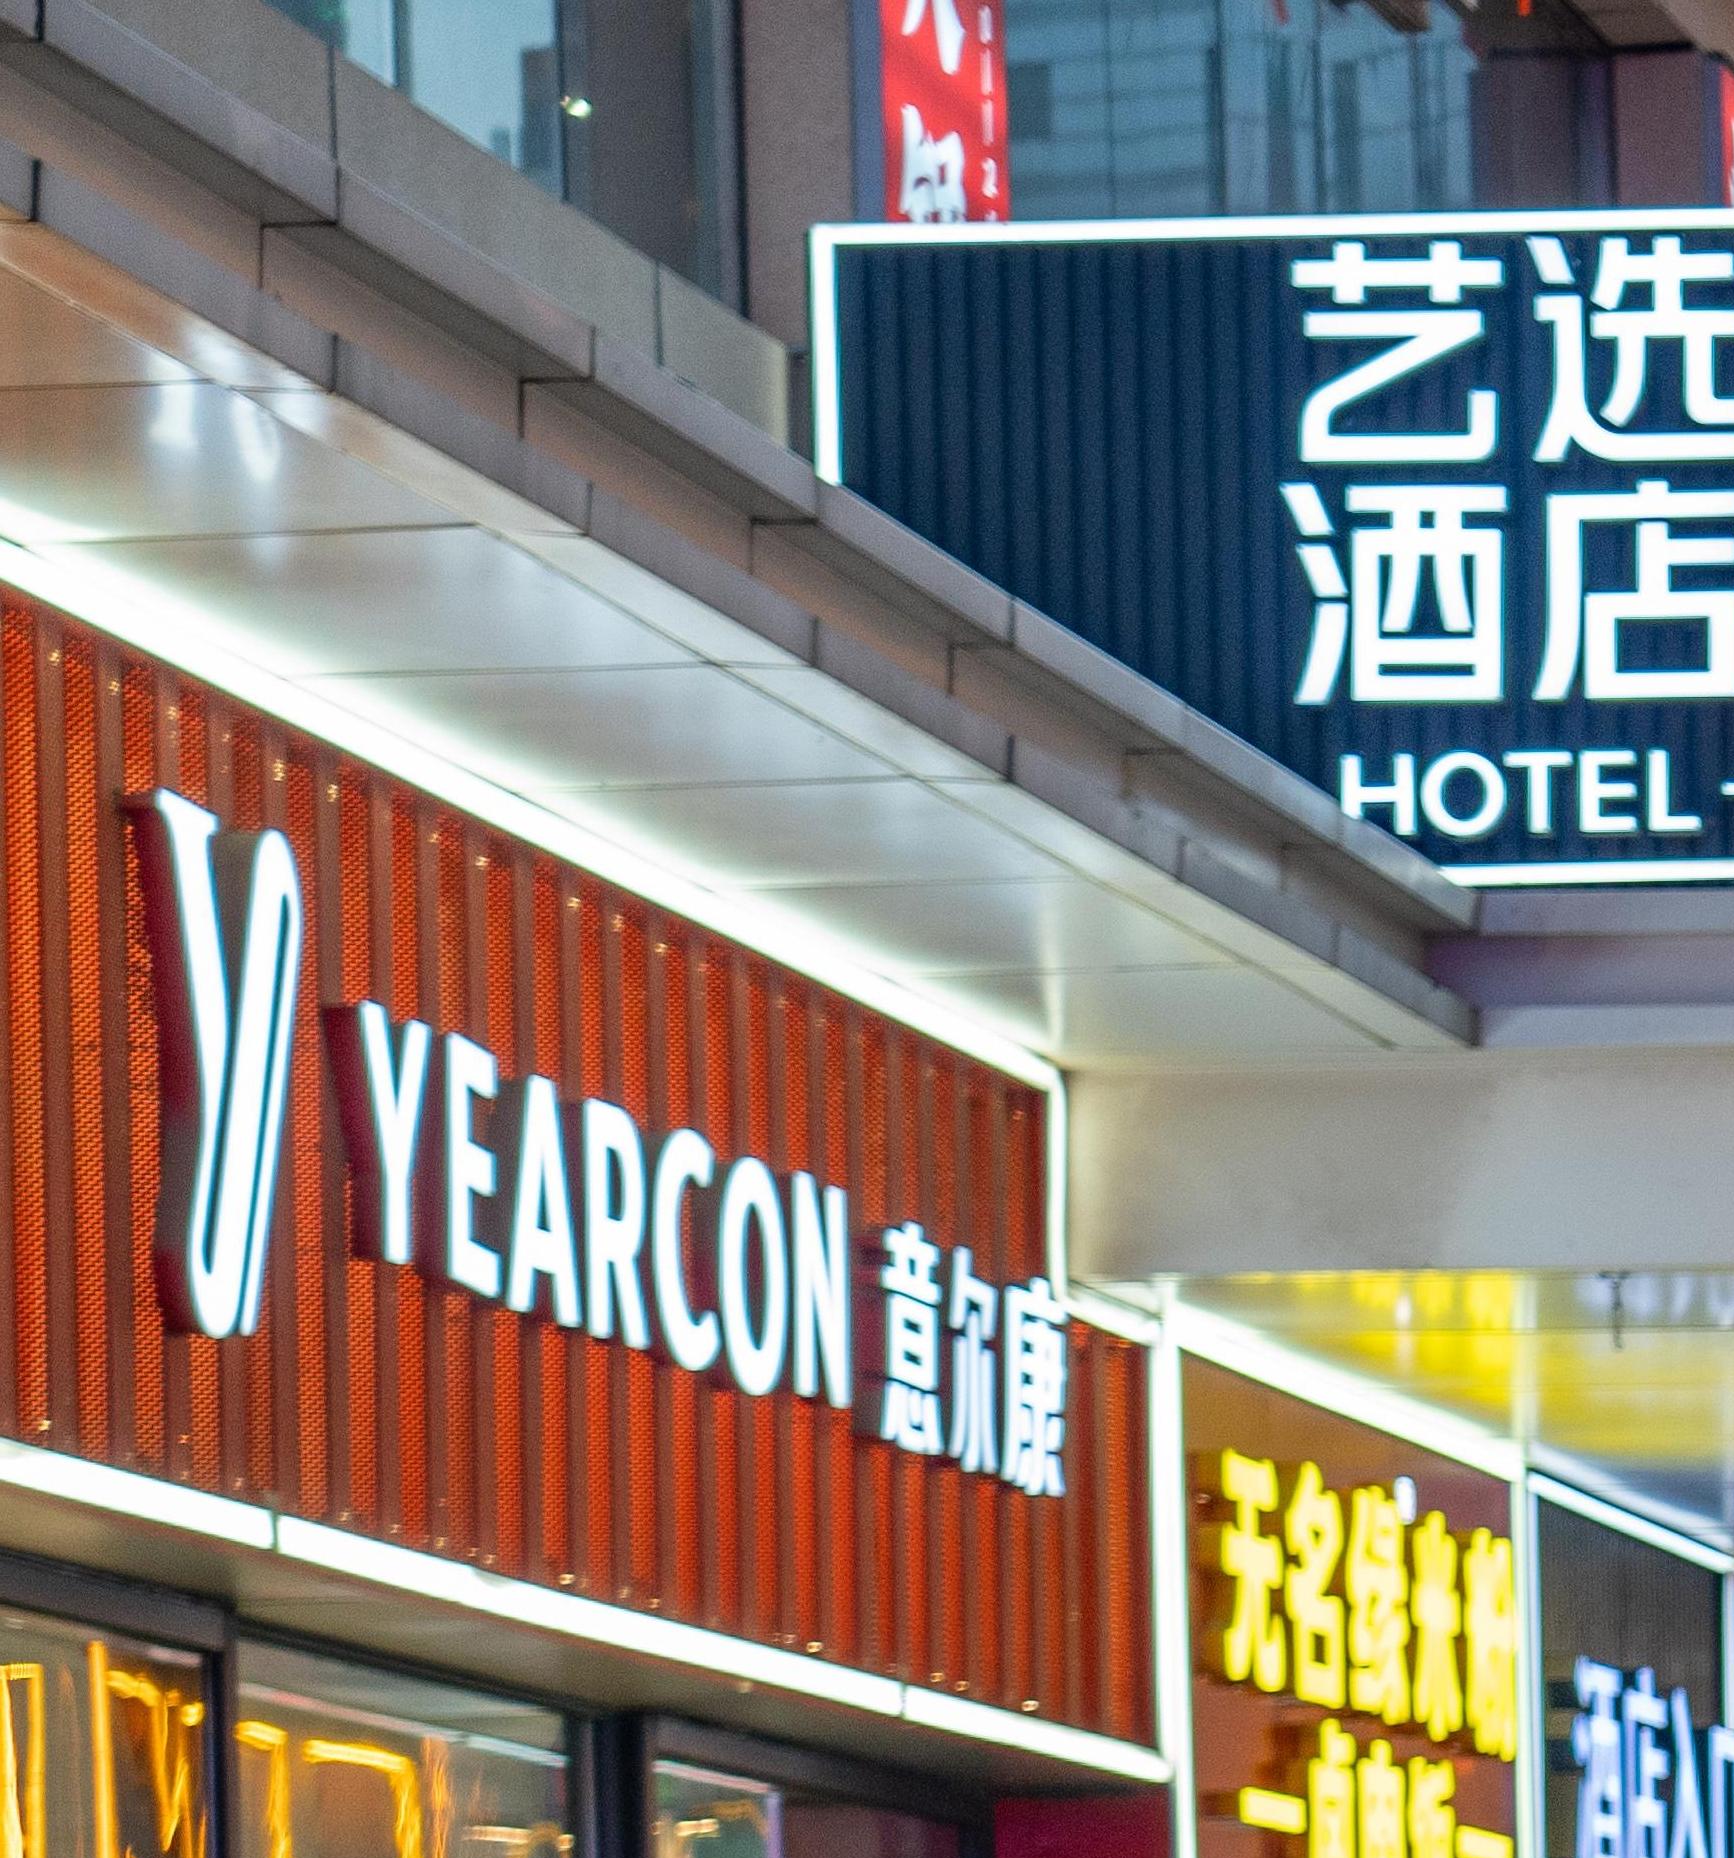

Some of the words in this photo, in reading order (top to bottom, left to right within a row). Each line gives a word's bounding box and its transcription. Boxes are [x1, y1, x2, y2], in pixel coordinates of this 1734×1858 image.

[1339, 749, 1703, 837] HOTEL
[361, 1001, 852, 1409] YEARCON
[882, 1221, 1070, 1498] 意尔康
[1220, 1447, 1517, 1762] 无名缘米粉
